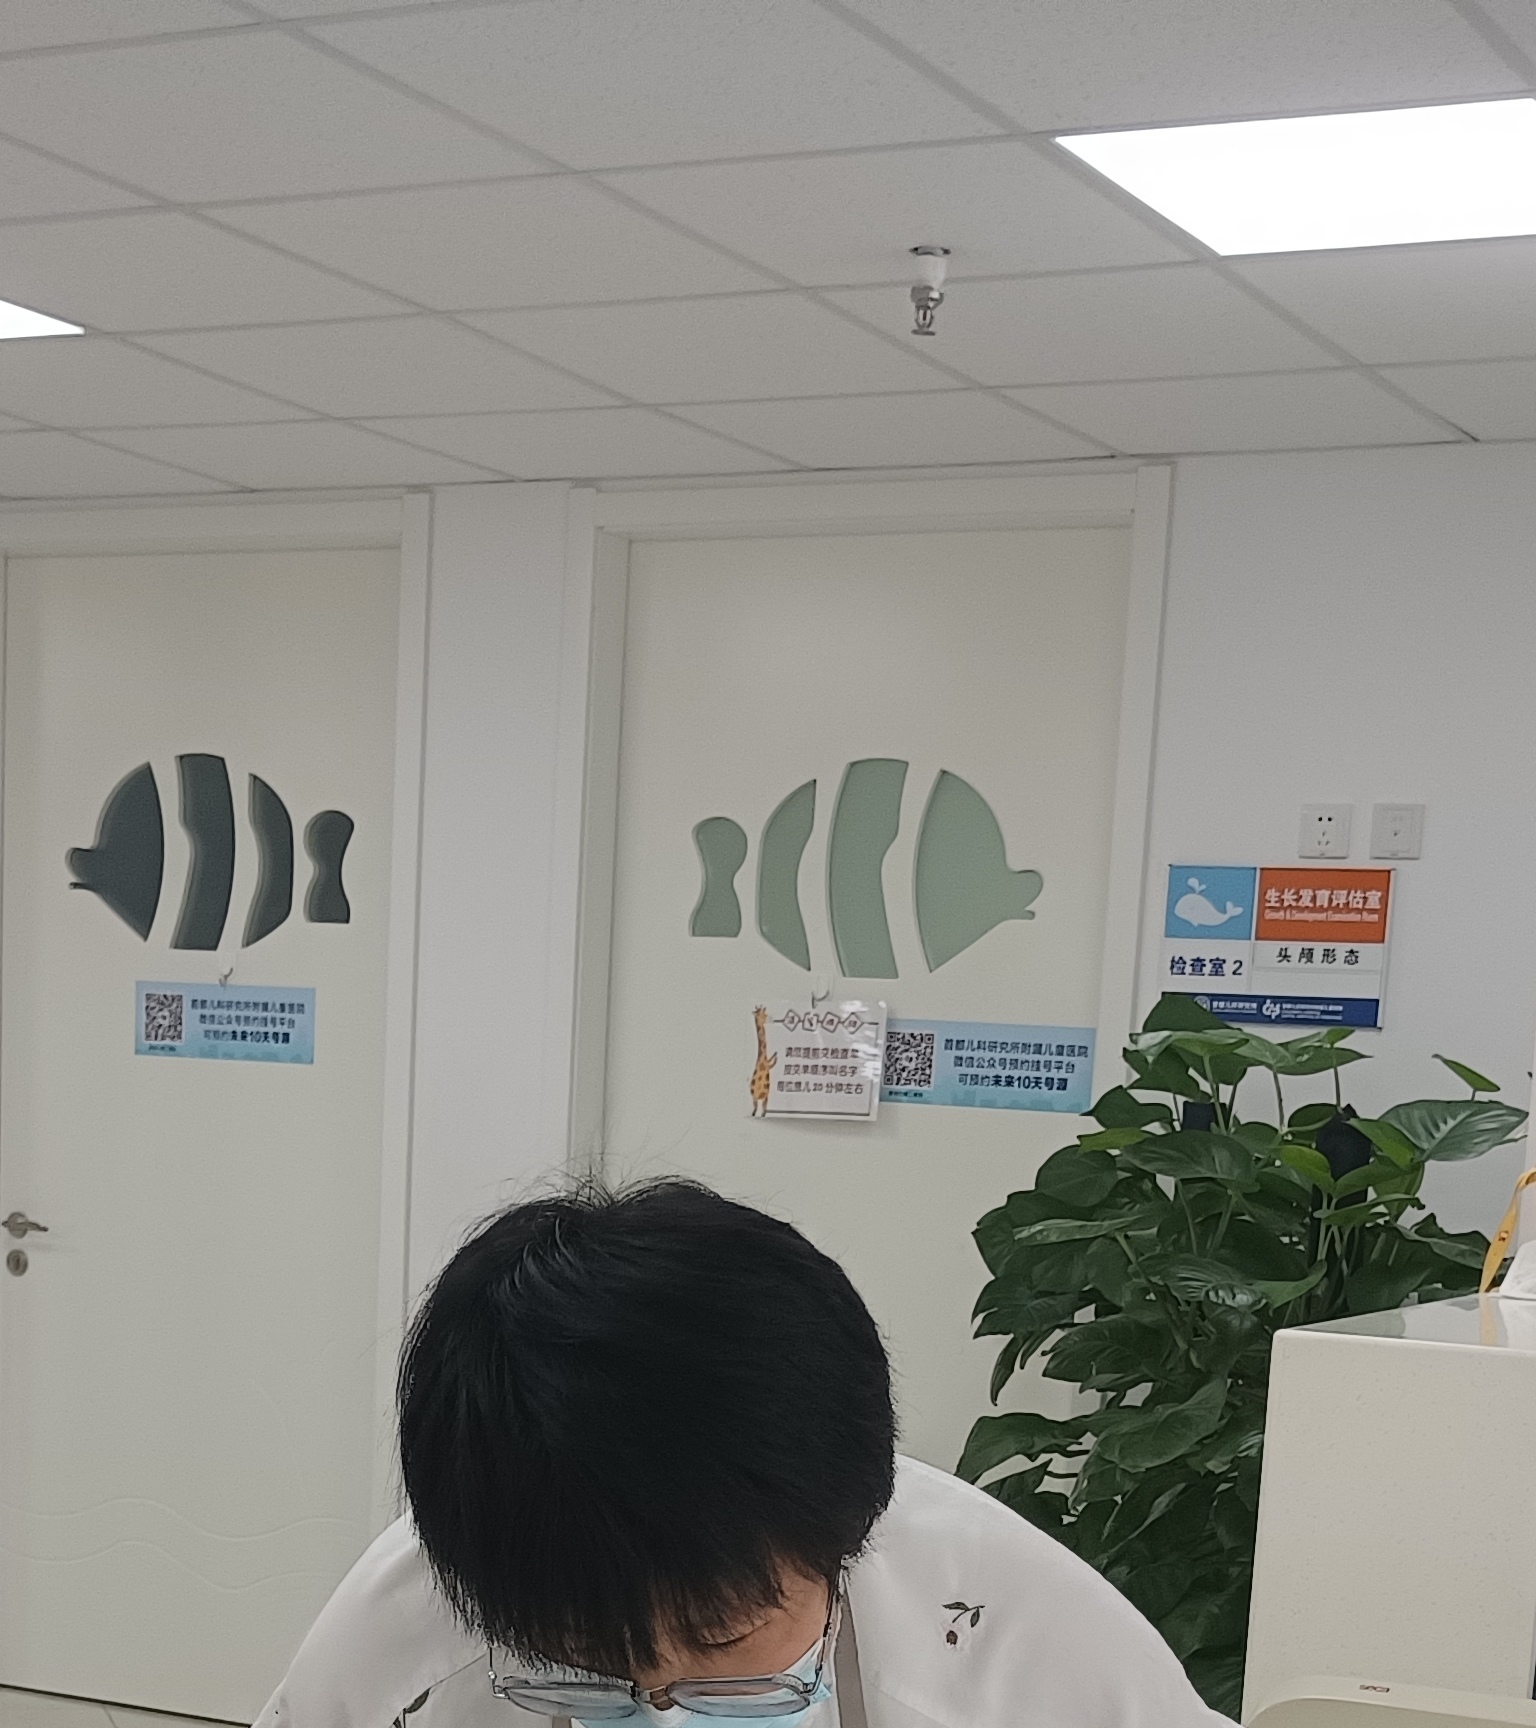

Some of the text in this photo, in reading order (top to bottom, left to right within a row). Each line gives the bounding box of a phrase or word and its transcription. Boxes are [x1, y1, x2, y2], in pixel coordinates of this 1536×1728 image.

[1265, 888, 1382, 909] 生长发育评估室
[1277, 947, 1360, 965] 头颅形态
[1170, 955, 1243, 977] 检查室 2
[954, 1056, 1075, 1074] 微信公众号预约挂号平台
[958, 1074, 1069, 1091] 可预约未来10天号源
